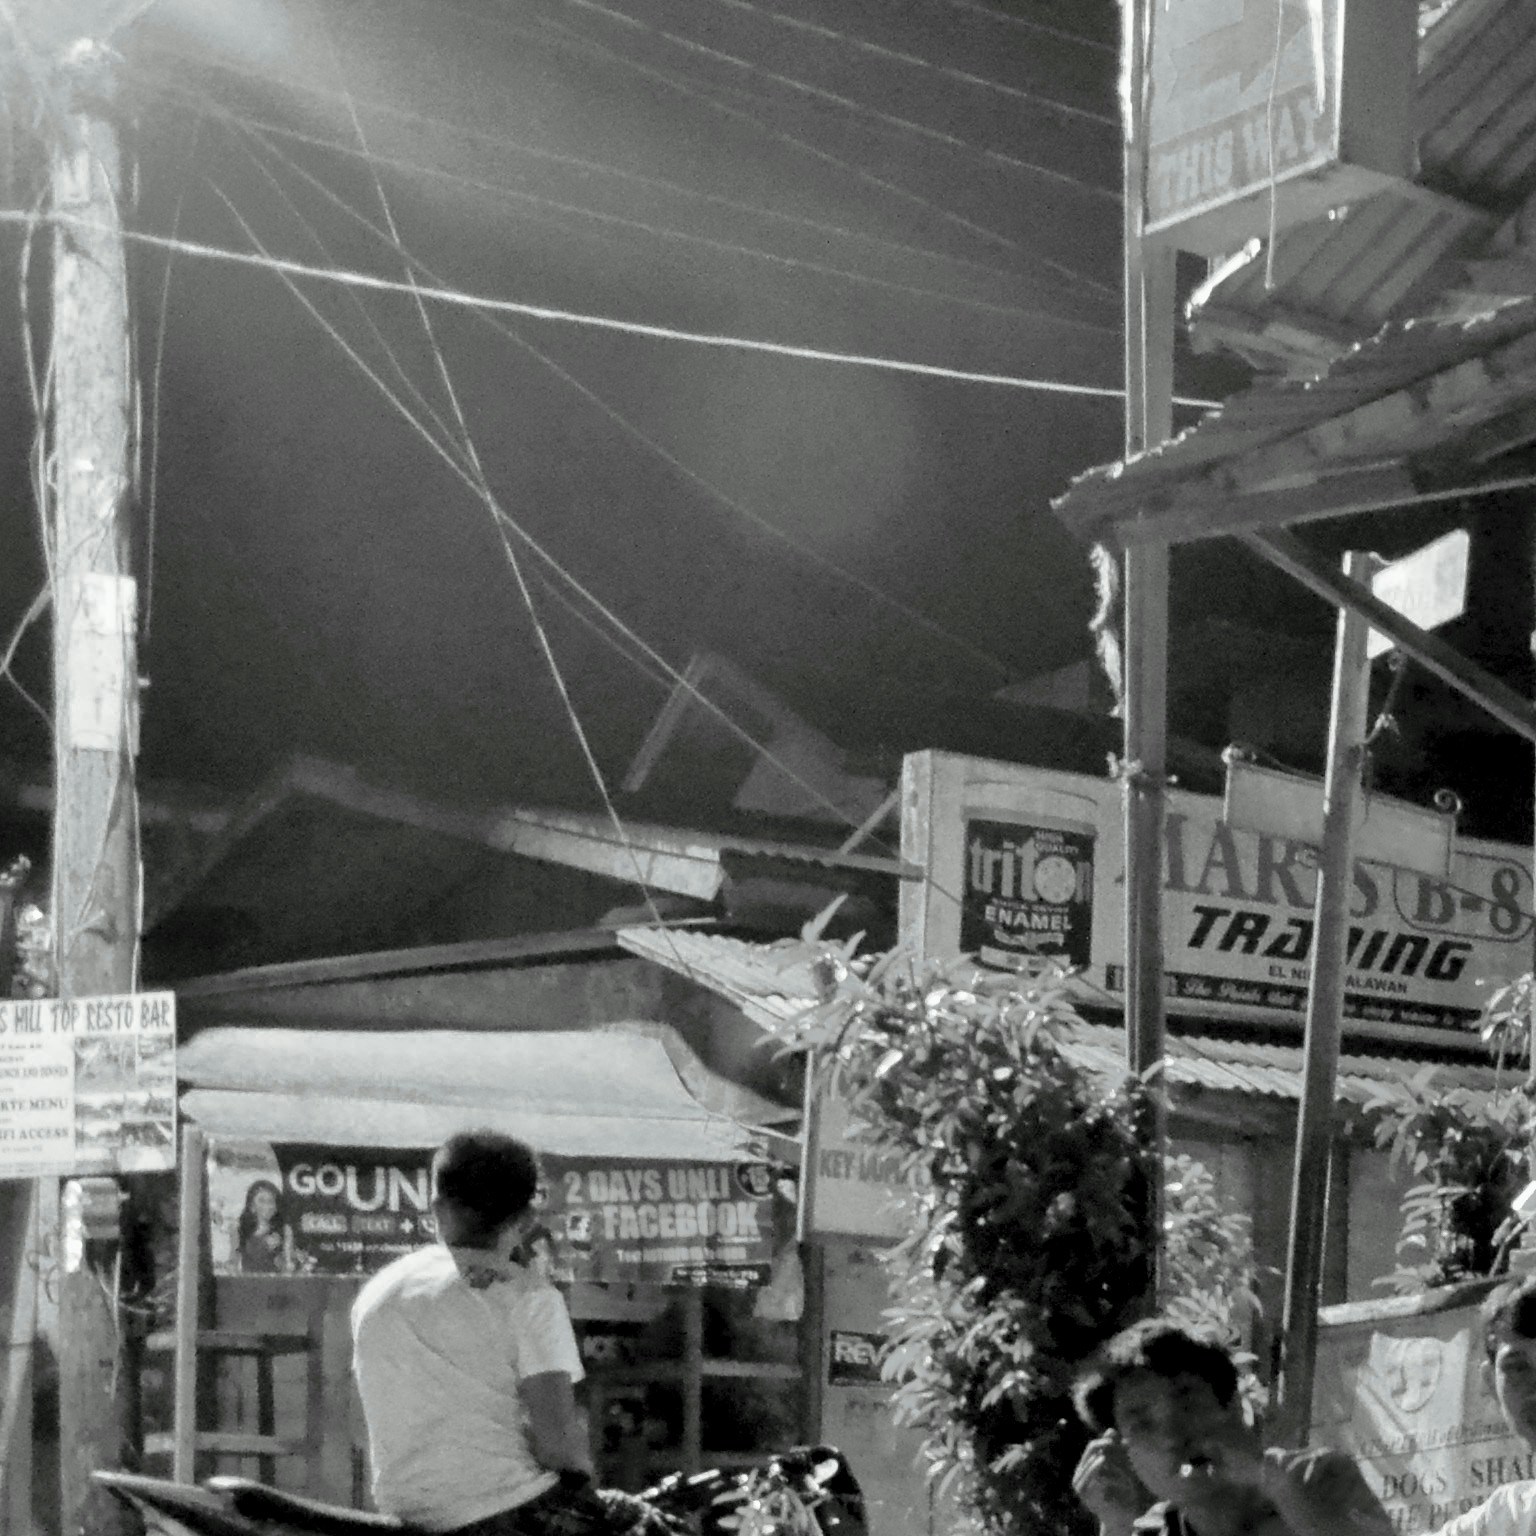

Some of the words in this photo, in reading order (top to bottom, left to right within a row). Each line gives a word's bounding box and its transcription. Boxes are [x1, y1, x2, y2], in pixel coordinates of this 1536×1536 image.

[1157, 129, 1234, 208] THIS
[1242, 99, 1323, 175] WAY
[985, 904, 1072, 931] ENAMEL
[1268, 965, 1286, 979] EL
[1345, 975, 1407, 994] ALAWAN
[15, 1002, 42, 1033] HILL
[51, 1001, 79, 1033] TOP
[86, 1001, 134, 1031] RESTO
[140, 1000, 170, 1028] BAR
[29, 1098, 68, 1111] MENU
[20, 1127, 69, 1140] ACCESS
[289, 1163, 429, 1212] GOUN
[563, 1170, 583, 1204] 2
[588, 1169, 664, 1202] DAYS
[668, 1167, 730, 1200] UNLI
[602, 1201, 761, 1241] FACEBOOK
[1383, 1470, 1446, 1498] DOGS
